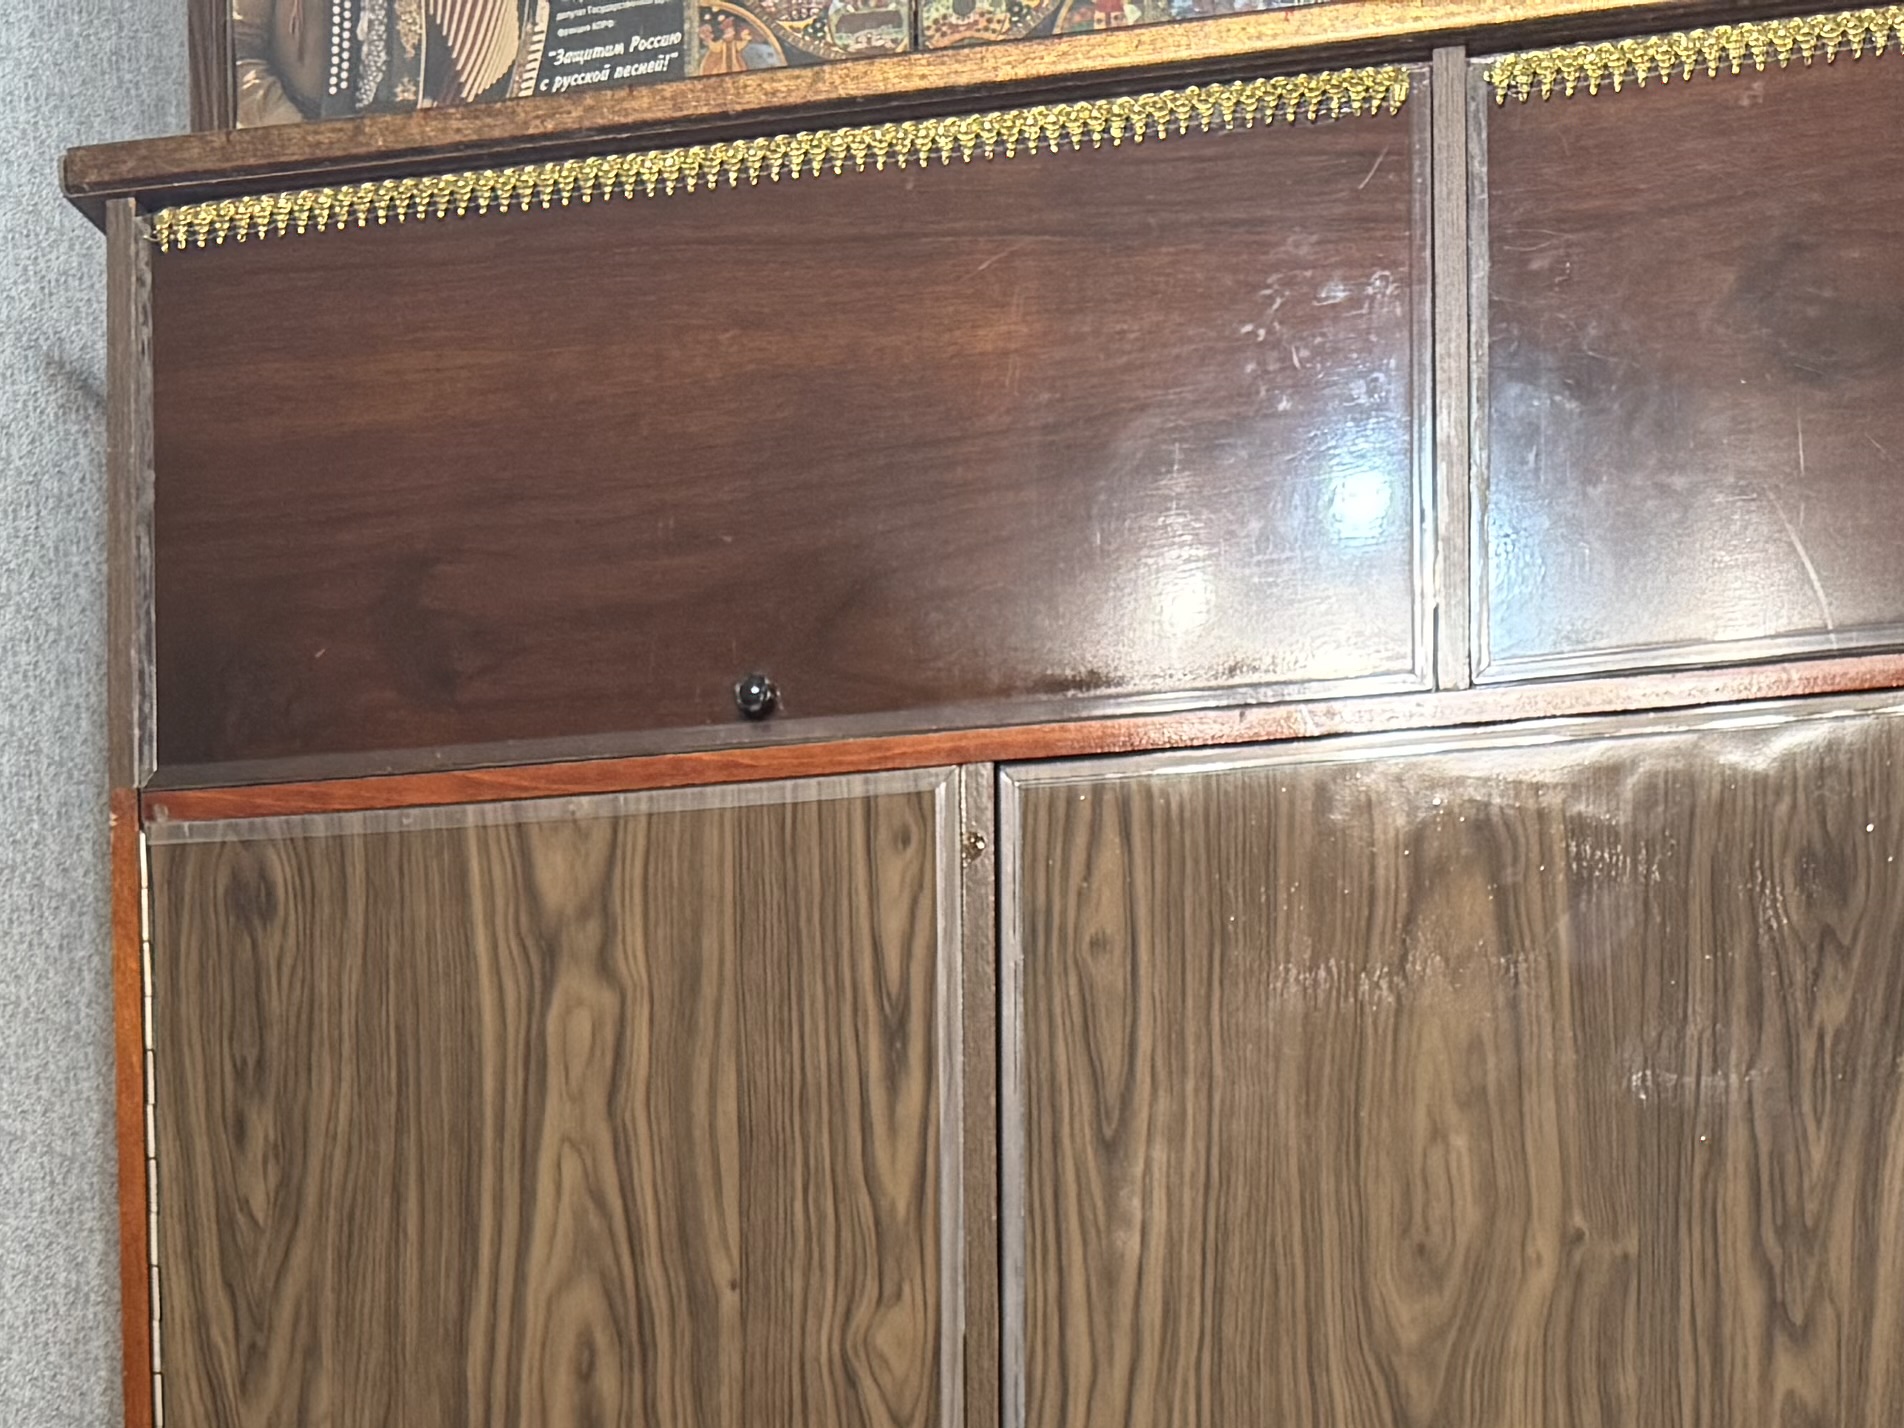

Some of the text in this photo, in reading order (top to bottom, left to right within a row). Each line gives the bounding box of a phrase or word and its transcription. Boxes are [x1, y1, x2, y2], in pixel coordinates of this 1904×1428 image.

[628, 31, 683, 54] Россию
[539, 78, 550, 92] с
[551, 63, 611, 93] русской
